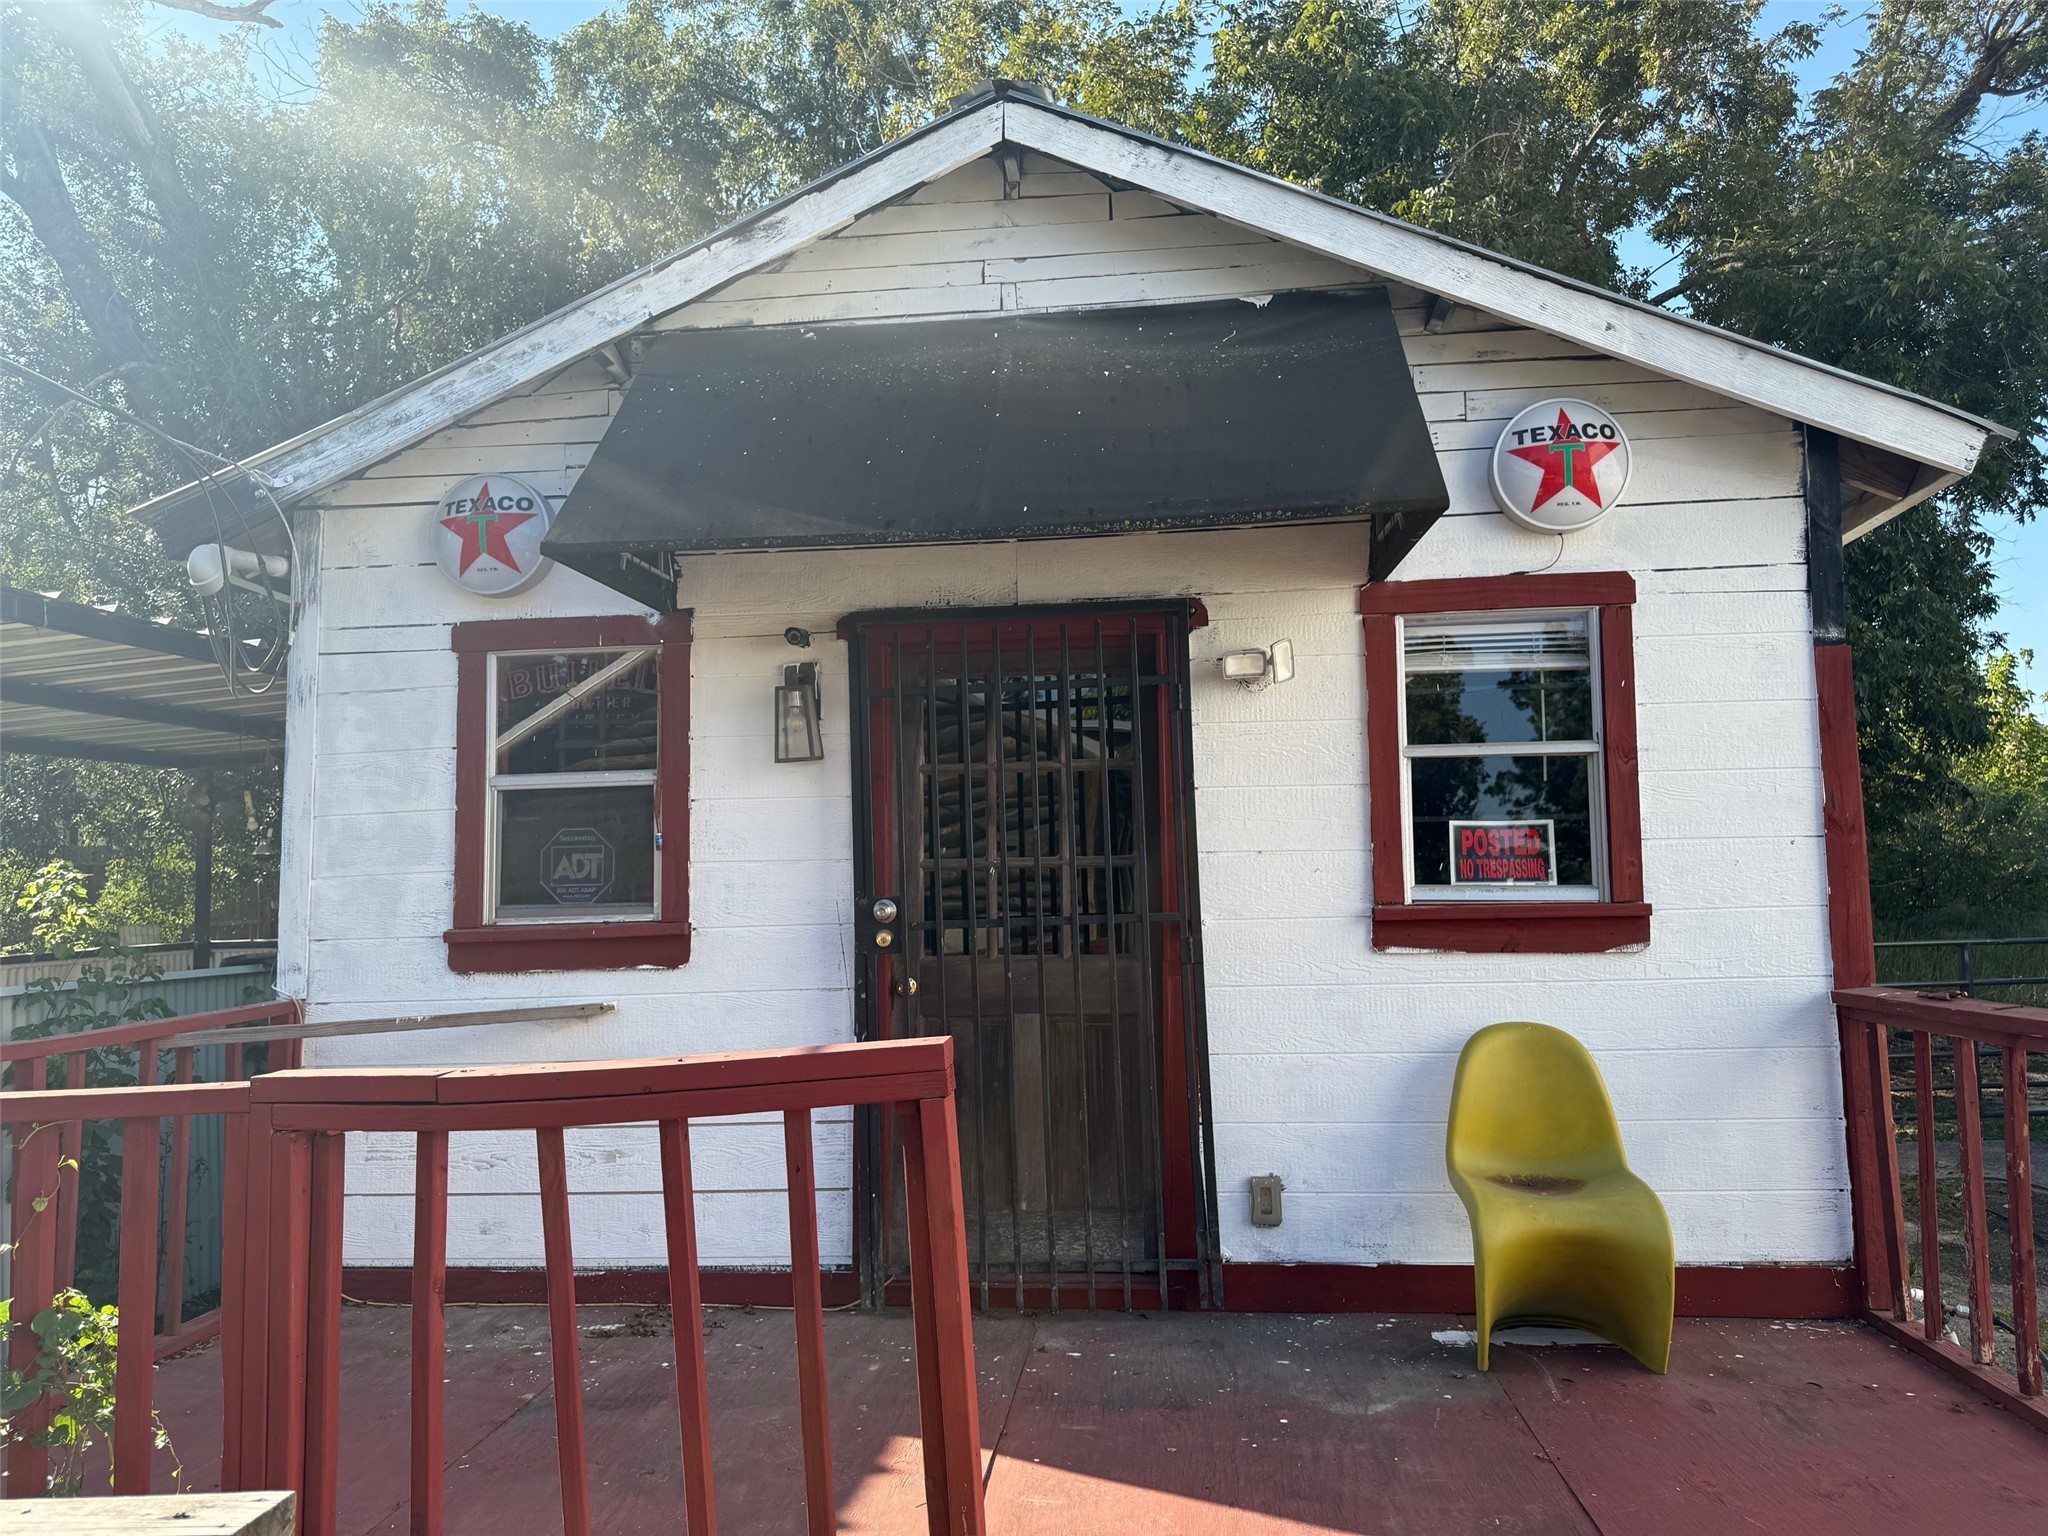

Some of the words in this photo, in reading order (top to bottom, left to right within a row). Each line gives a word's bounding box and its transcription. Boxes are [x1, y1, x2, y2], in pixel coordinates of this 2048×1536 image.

[1512, 423, 1616, 445] TEXACO
[1549, 443, 1585, 487] T
[445, 496, 534, 516] TEXACO
[467, 513, 498, 554] T
[560, 834, 587, 842] Secured
[588, 834, 596, 842] by
[1461, 828, 1541, 856] POSTED
[553, 853, 603, 880] ADT
[1460, 859, 1474, 879] NO
[1477, 858, 1546, 880] TRESPASSING
